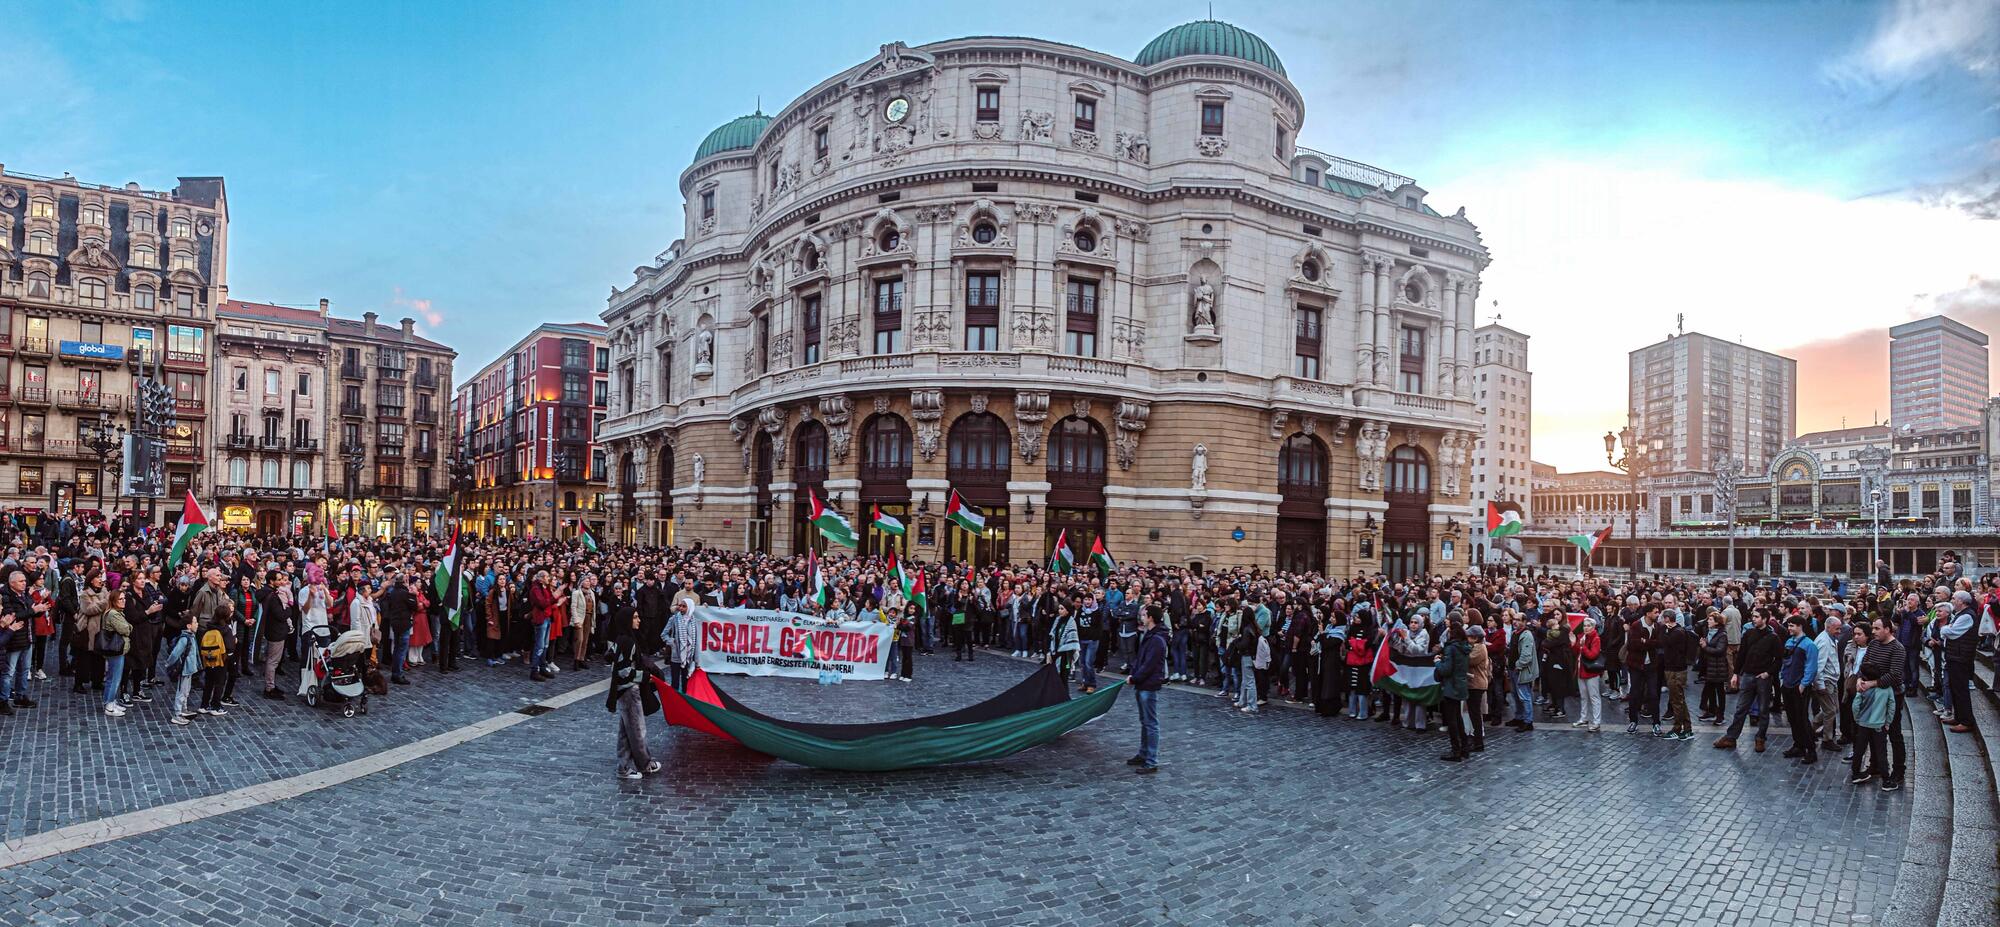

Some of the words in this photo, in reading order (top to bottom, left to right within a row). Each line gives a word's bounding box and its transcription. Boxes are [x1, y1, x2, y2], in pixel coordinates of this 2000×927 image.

[79, 344, 105, 354] global
[701, 621, 773, 654] ISRAEL
[726, 655, 766, 665] PALESTINAR
